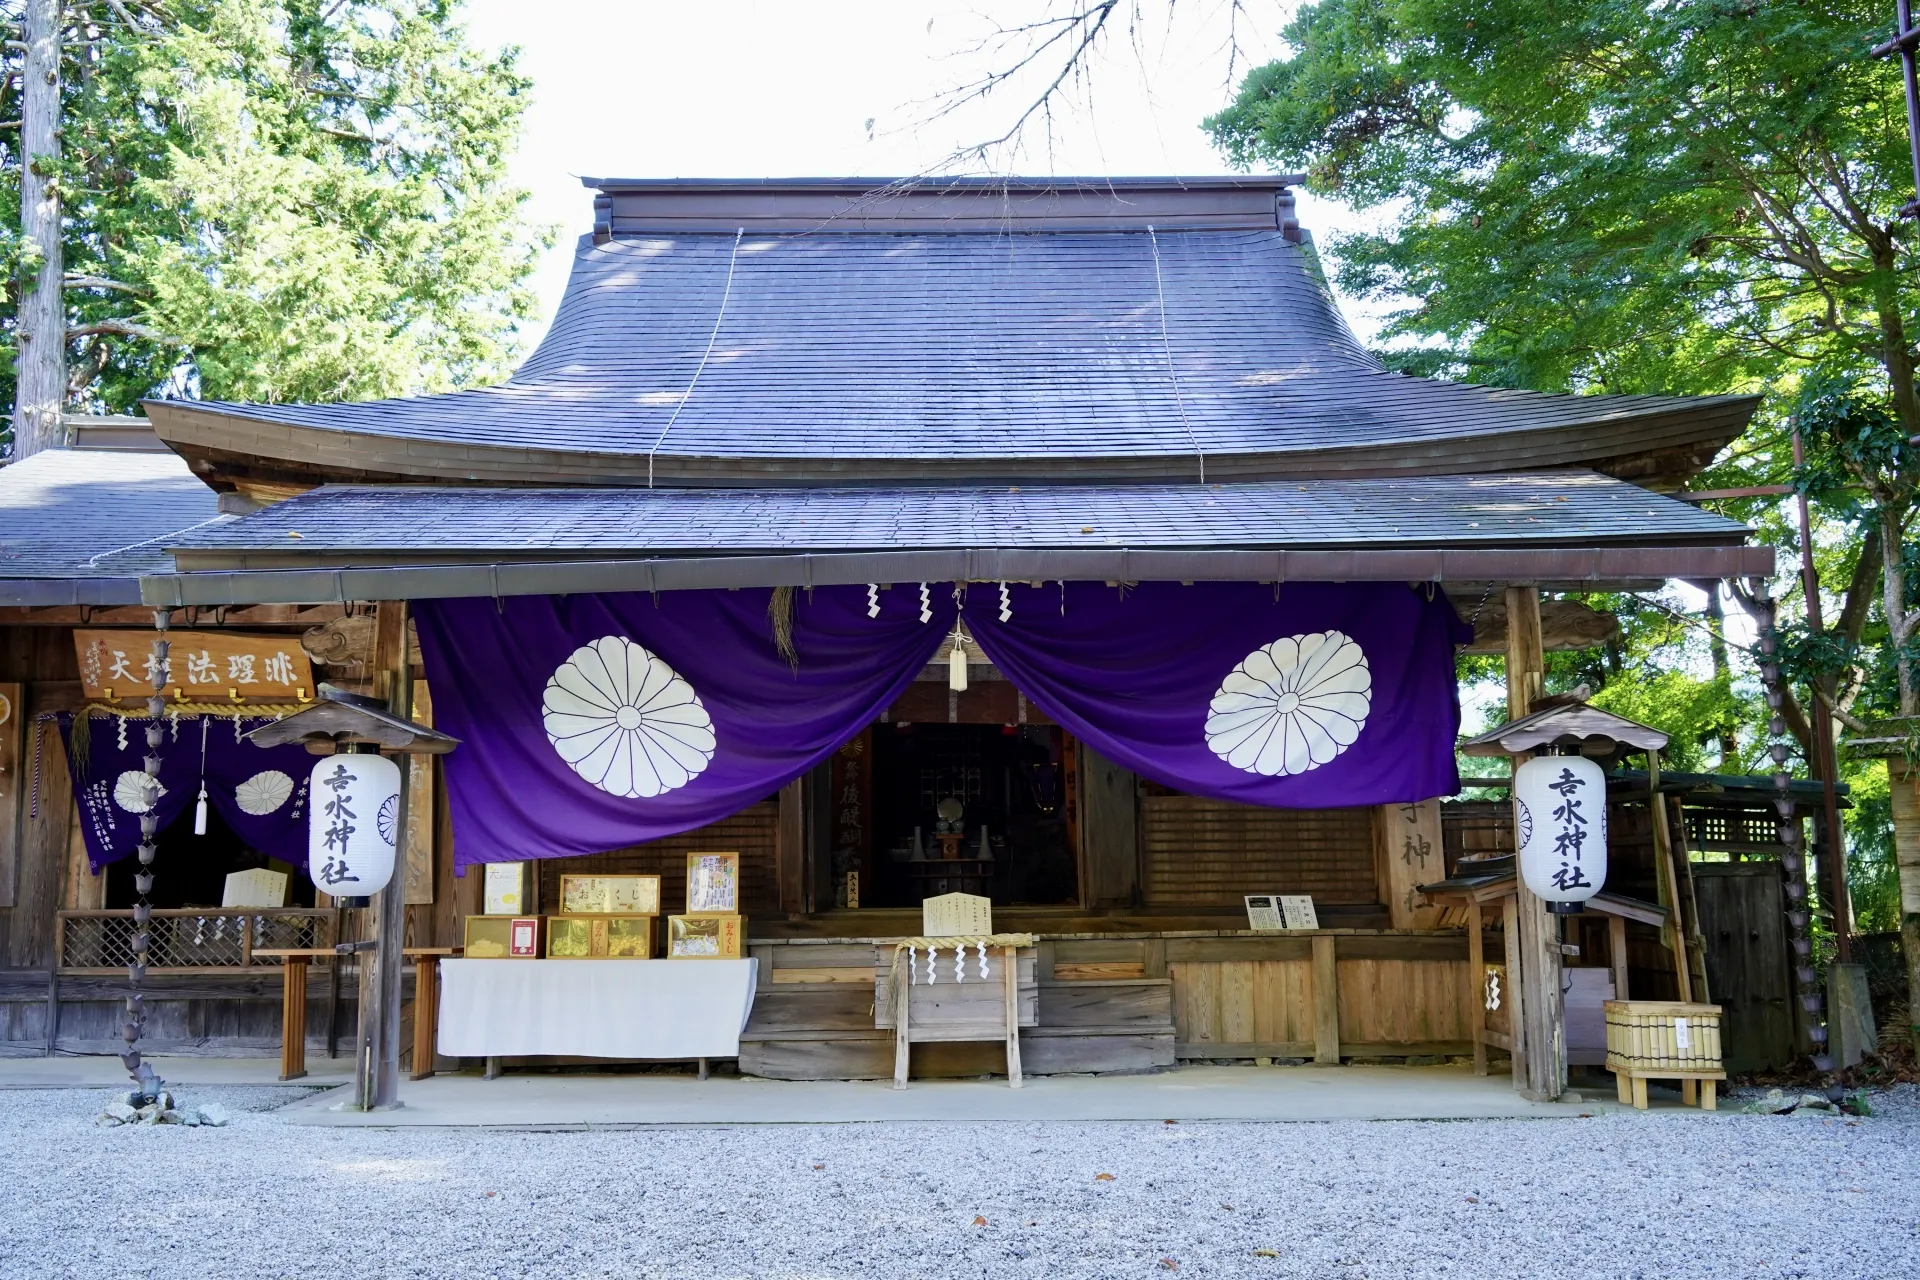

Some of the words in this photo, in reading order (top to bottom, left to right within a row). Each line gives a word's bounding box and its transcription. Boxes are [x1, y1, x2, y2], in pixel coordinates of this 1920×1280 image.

[578, 888, 640, 901] おみくじ
[725, 921, 734, 954] おみくじ
